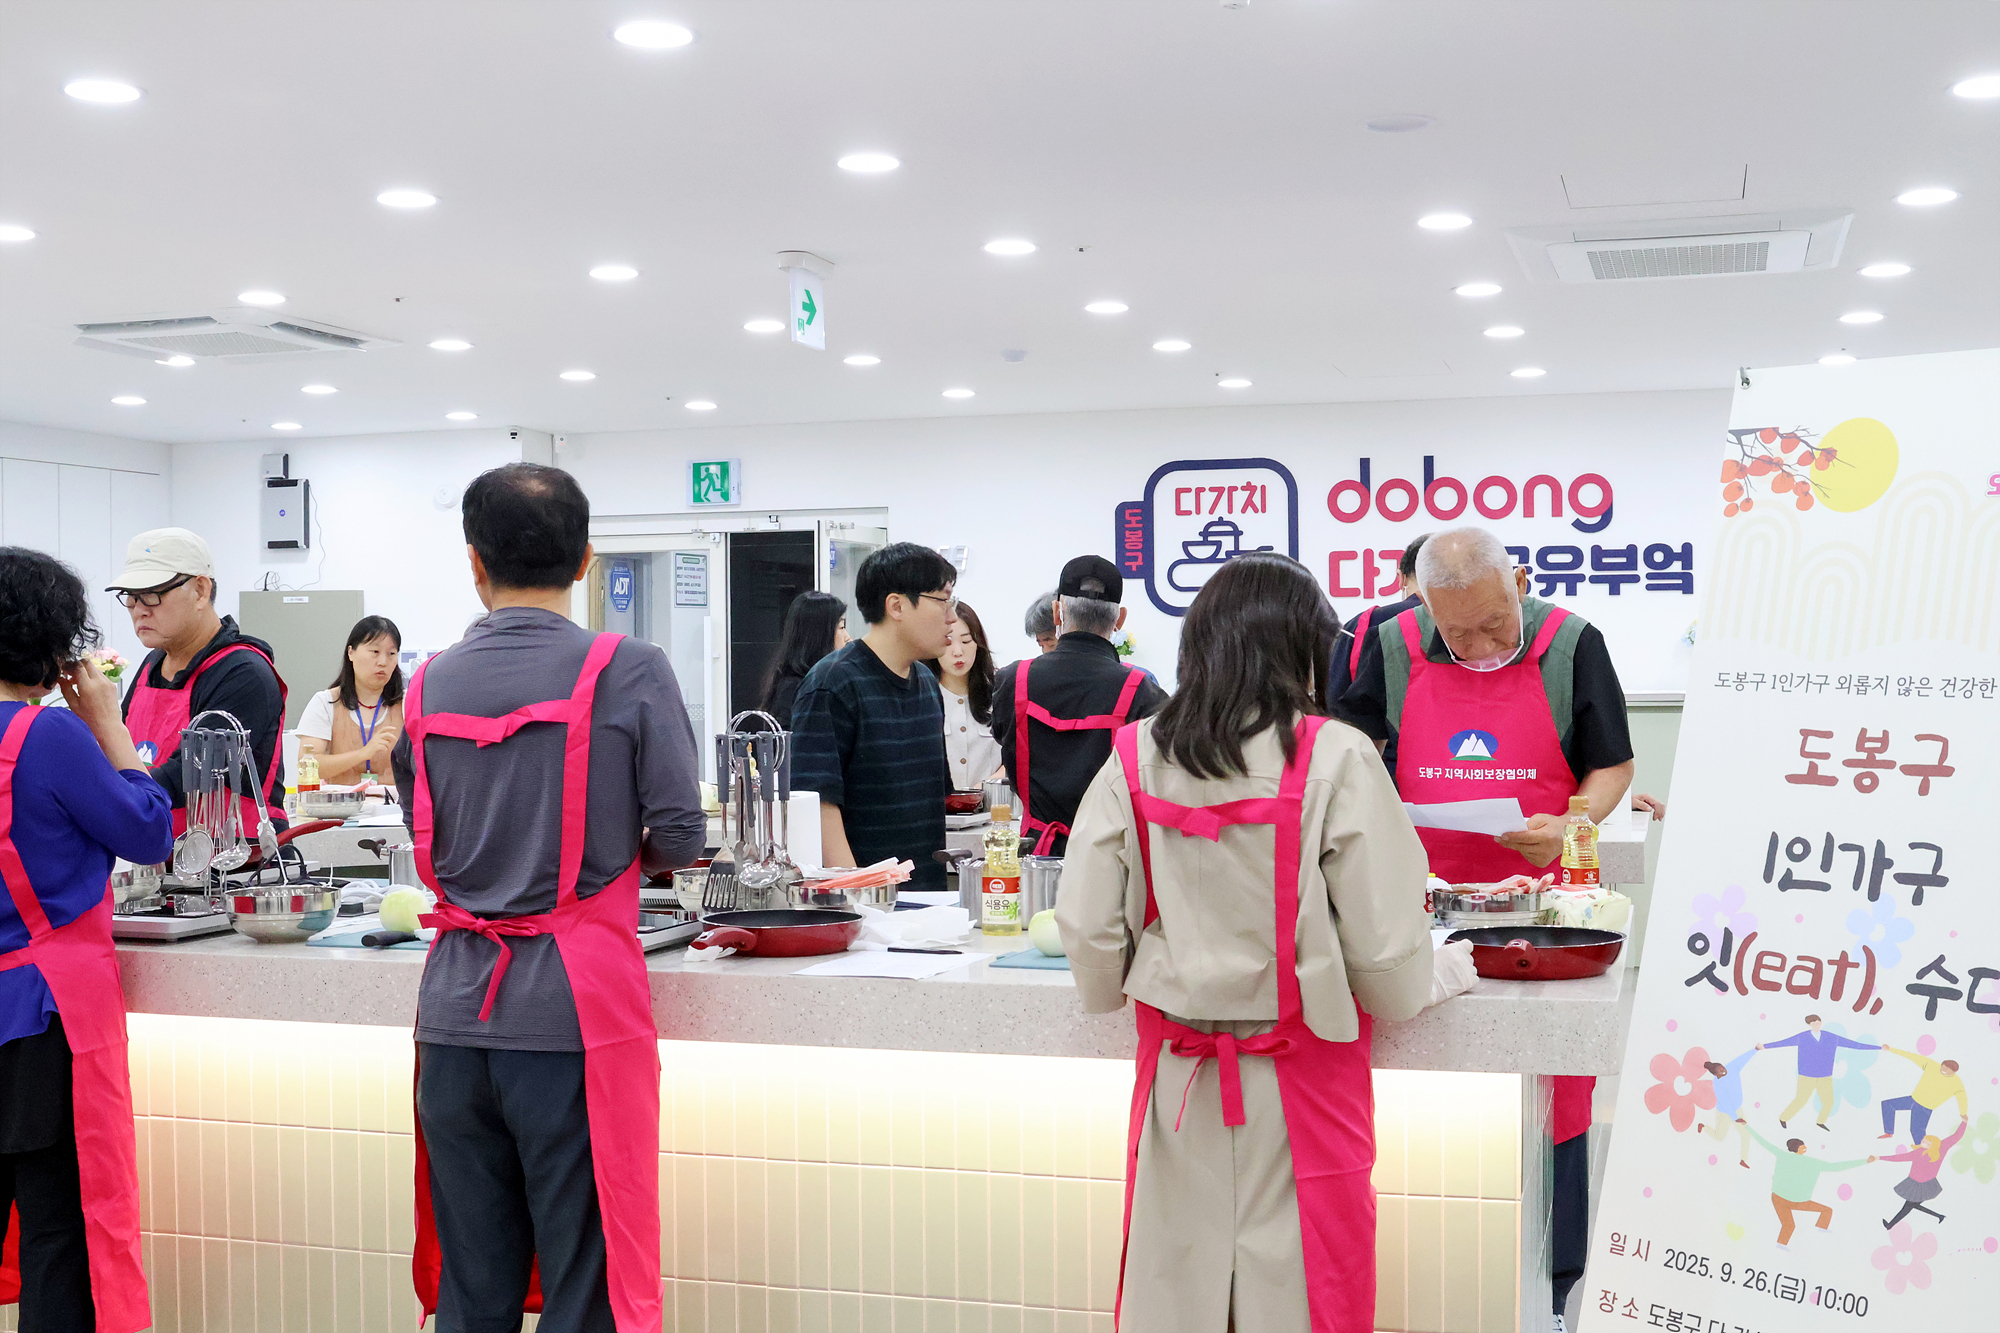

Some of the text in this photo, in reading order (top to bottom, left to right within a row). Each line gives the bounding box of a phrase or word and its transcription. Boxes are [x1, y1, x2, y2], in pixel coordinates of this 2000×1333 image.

[1175, 481, 1267, 516] 다가치
[1327, 455, 1614, 533] dobong
[1124, 508, 1144, 572] 도봉구
[613, 577, 630, 596] ADT
[1714, 671, 1998, 699] 도봉구 1인가구 외롭지 않은 건강한
[1418, 767, 1537, 781] 도봉구 지역사회보장협의체
[1784, 727, 1956, 797] 도봉구
[985, 899, 1010, 911] 식용유
[1663, 1248, 1713, 1279] 2025.
[1720, 1262, 1736, 1285] 9.
[1743, 1268, 1806, 1304] 26.(금)
[1814, 1285, 1869, 1318] 10:00
